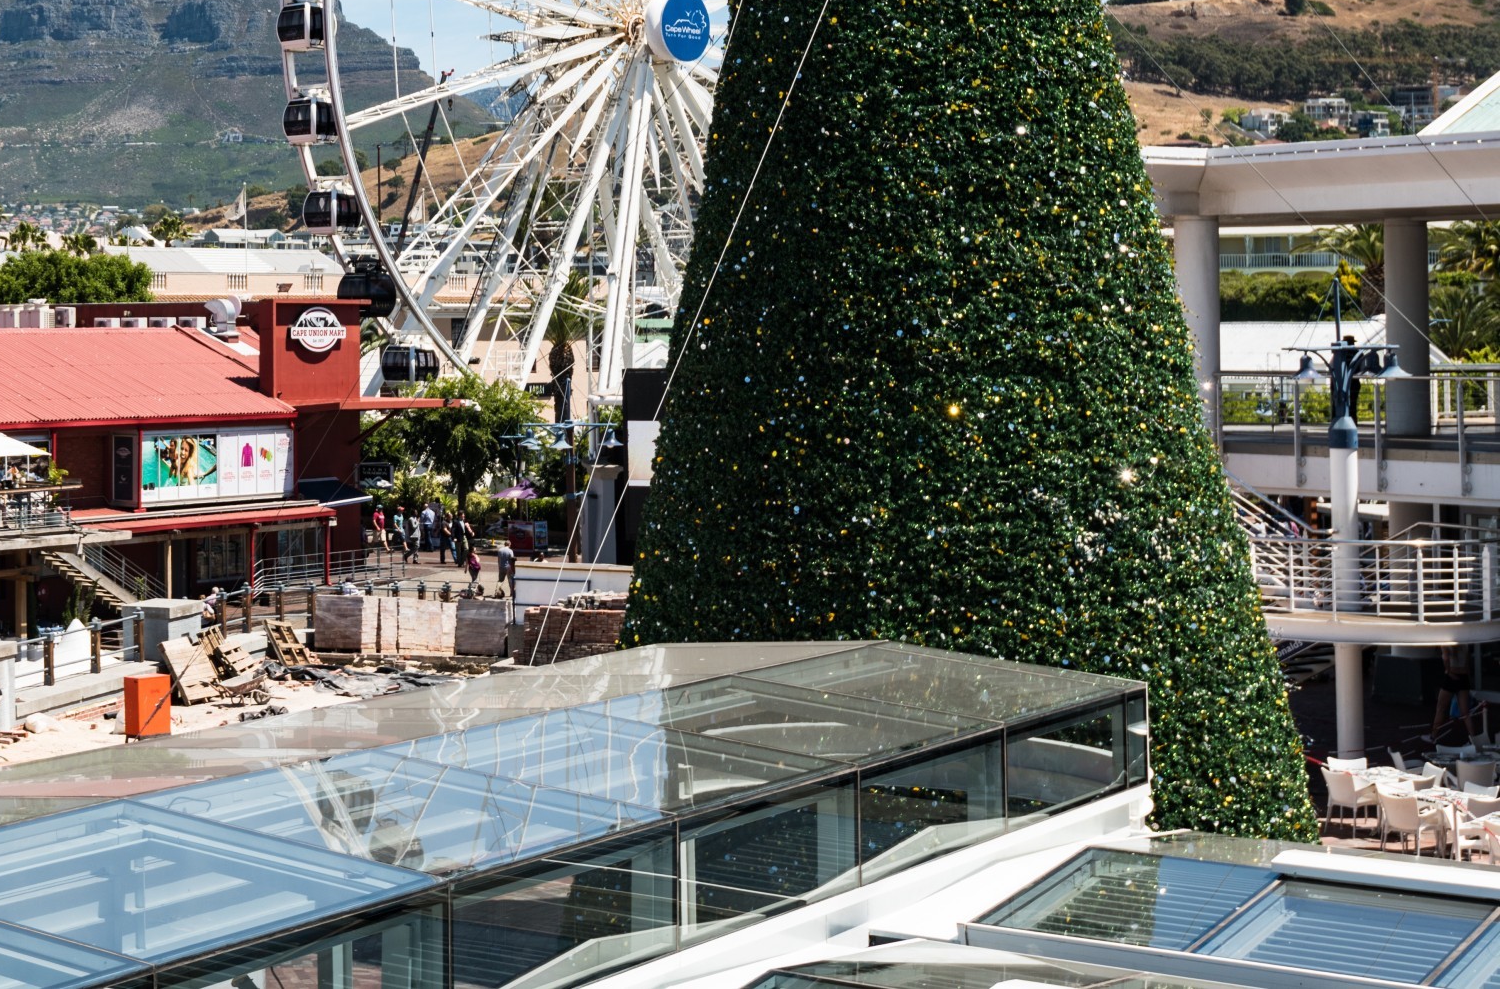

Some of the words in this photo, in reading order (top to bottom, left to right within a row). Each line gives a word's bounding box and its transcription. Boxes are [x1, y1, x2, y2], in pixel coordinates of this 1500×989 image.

[292, 329, 307, 337] CAPE
[309, 329, 328, 337] UNION
[329, 329, 345, 337] MART
